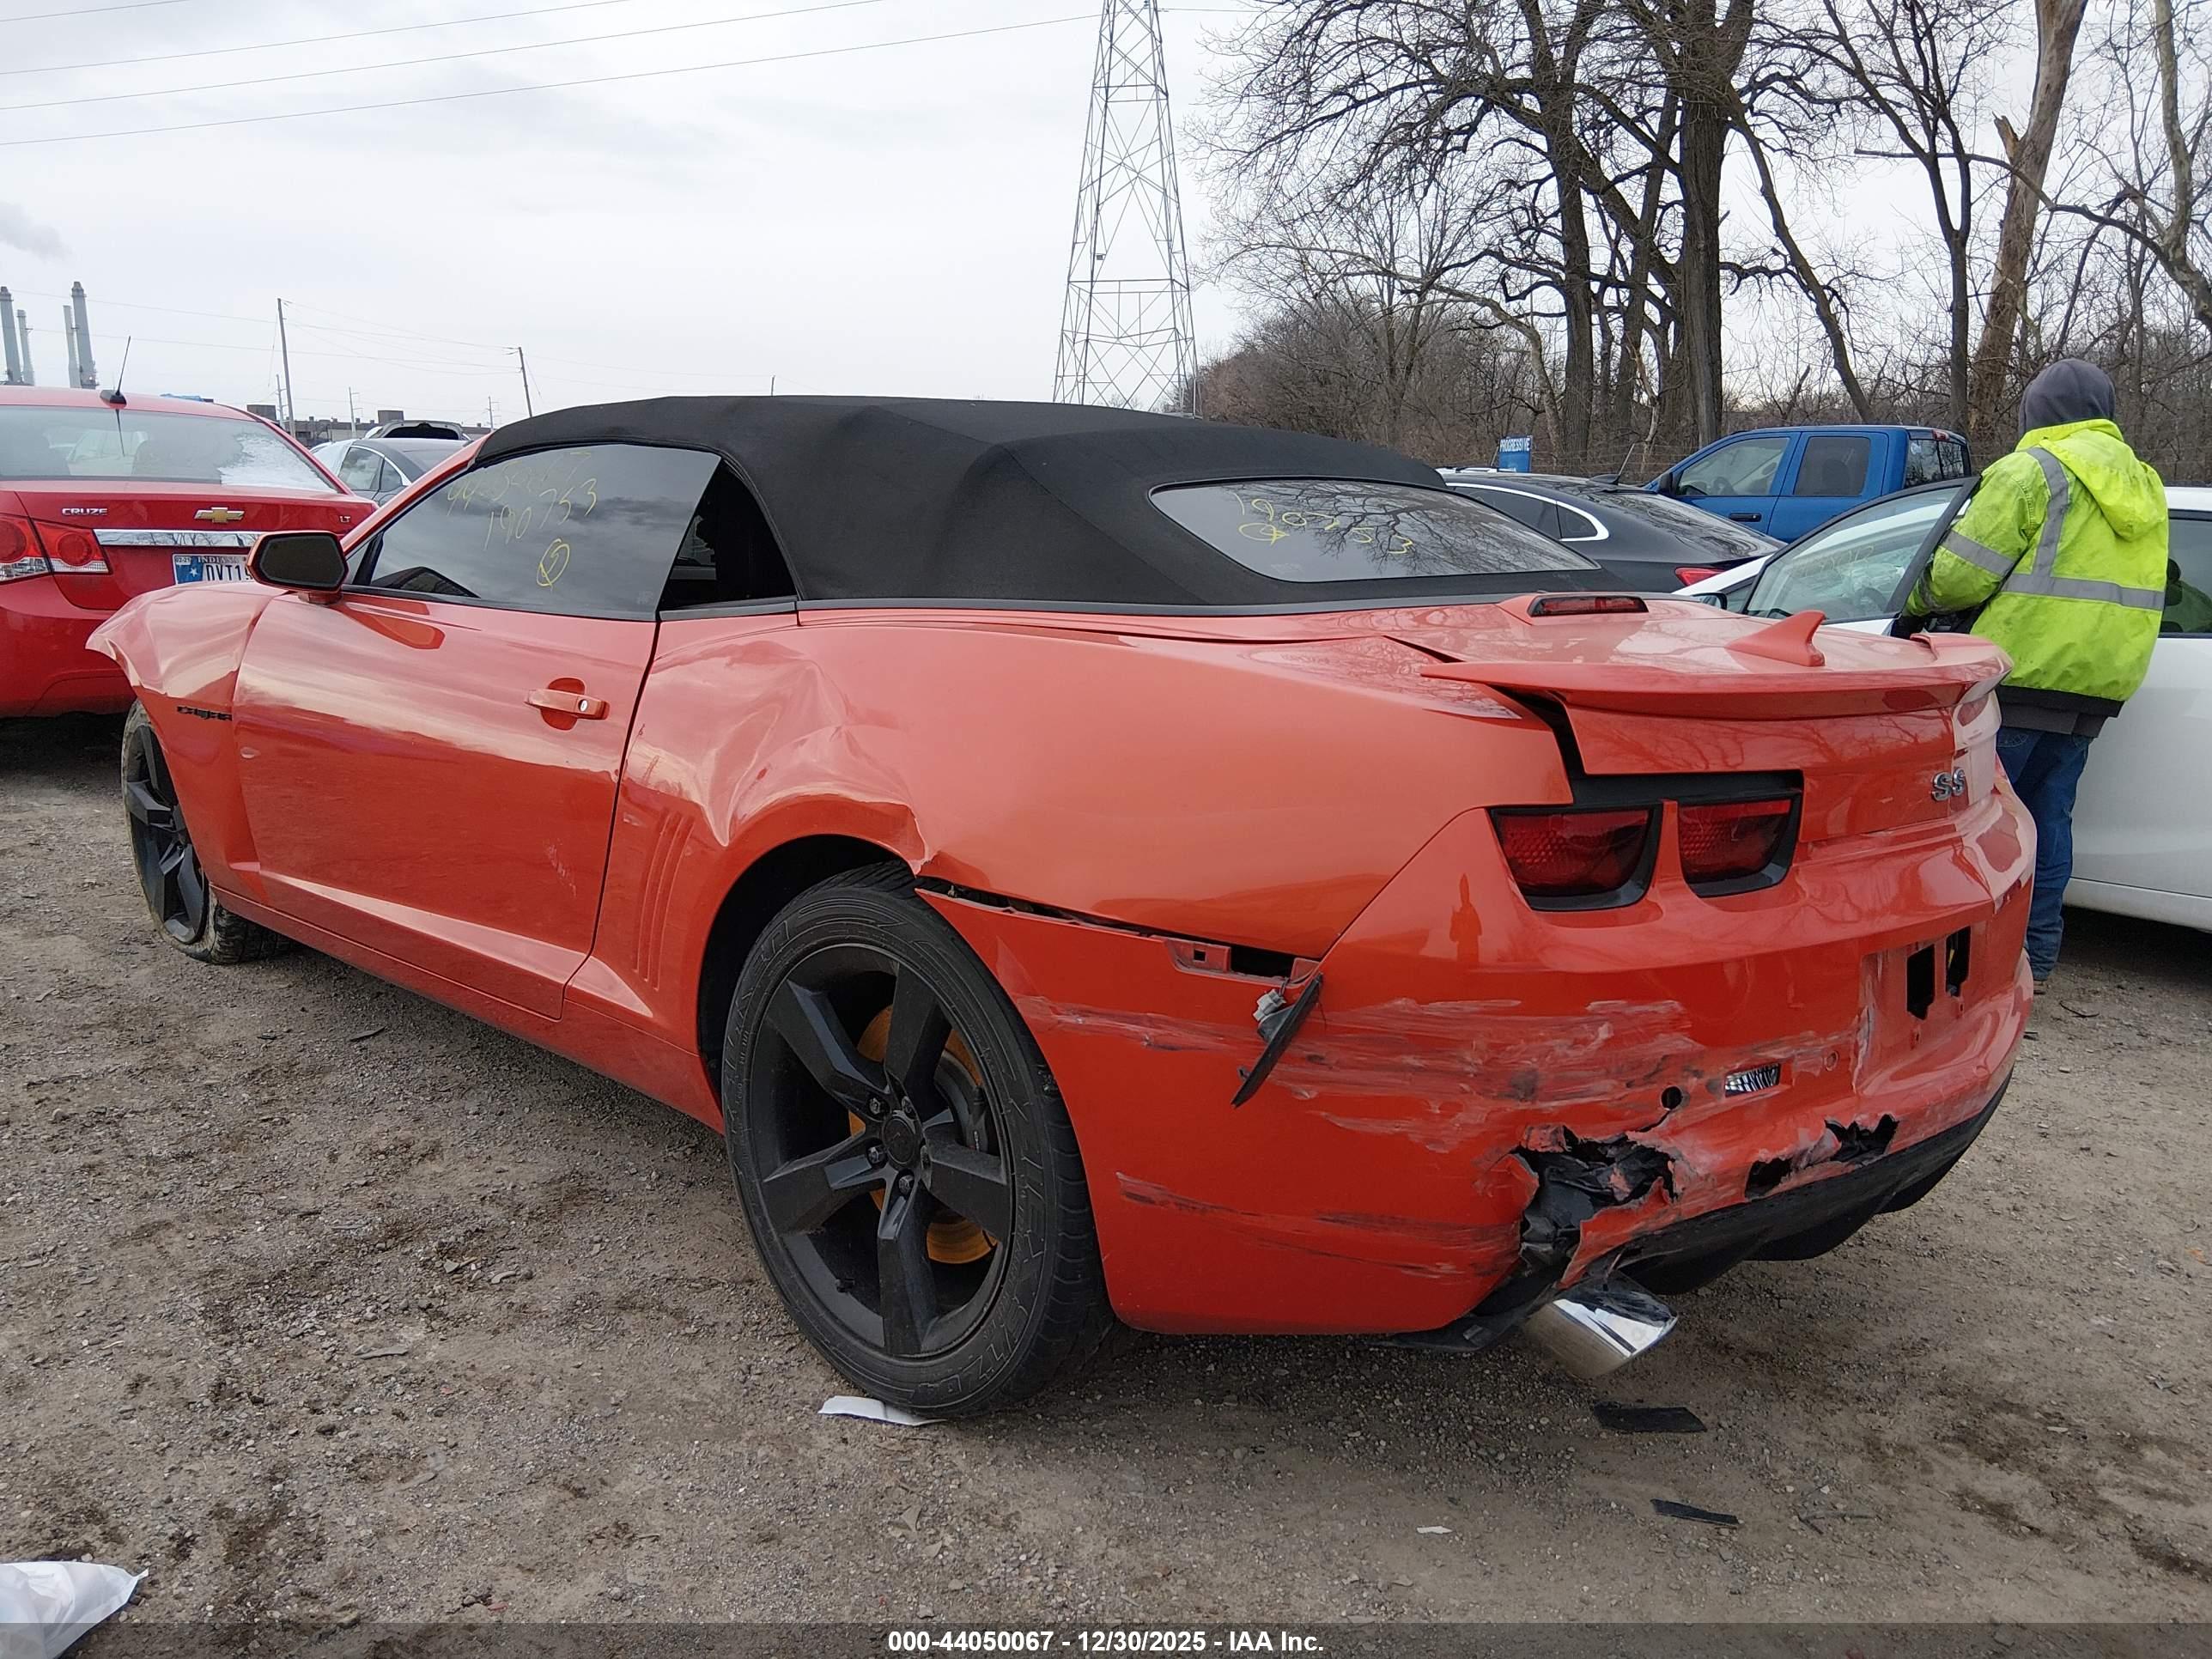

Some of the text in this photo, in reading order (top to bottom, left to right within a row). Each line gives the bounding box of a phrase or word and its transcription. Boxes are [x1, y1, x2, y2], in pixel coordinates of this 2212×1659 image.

[1499, 437, 1530, 452] PROGRESSIVE
[62, 507, 108, 516] CRUZE
[1930, 768, 1966, 801] SS
